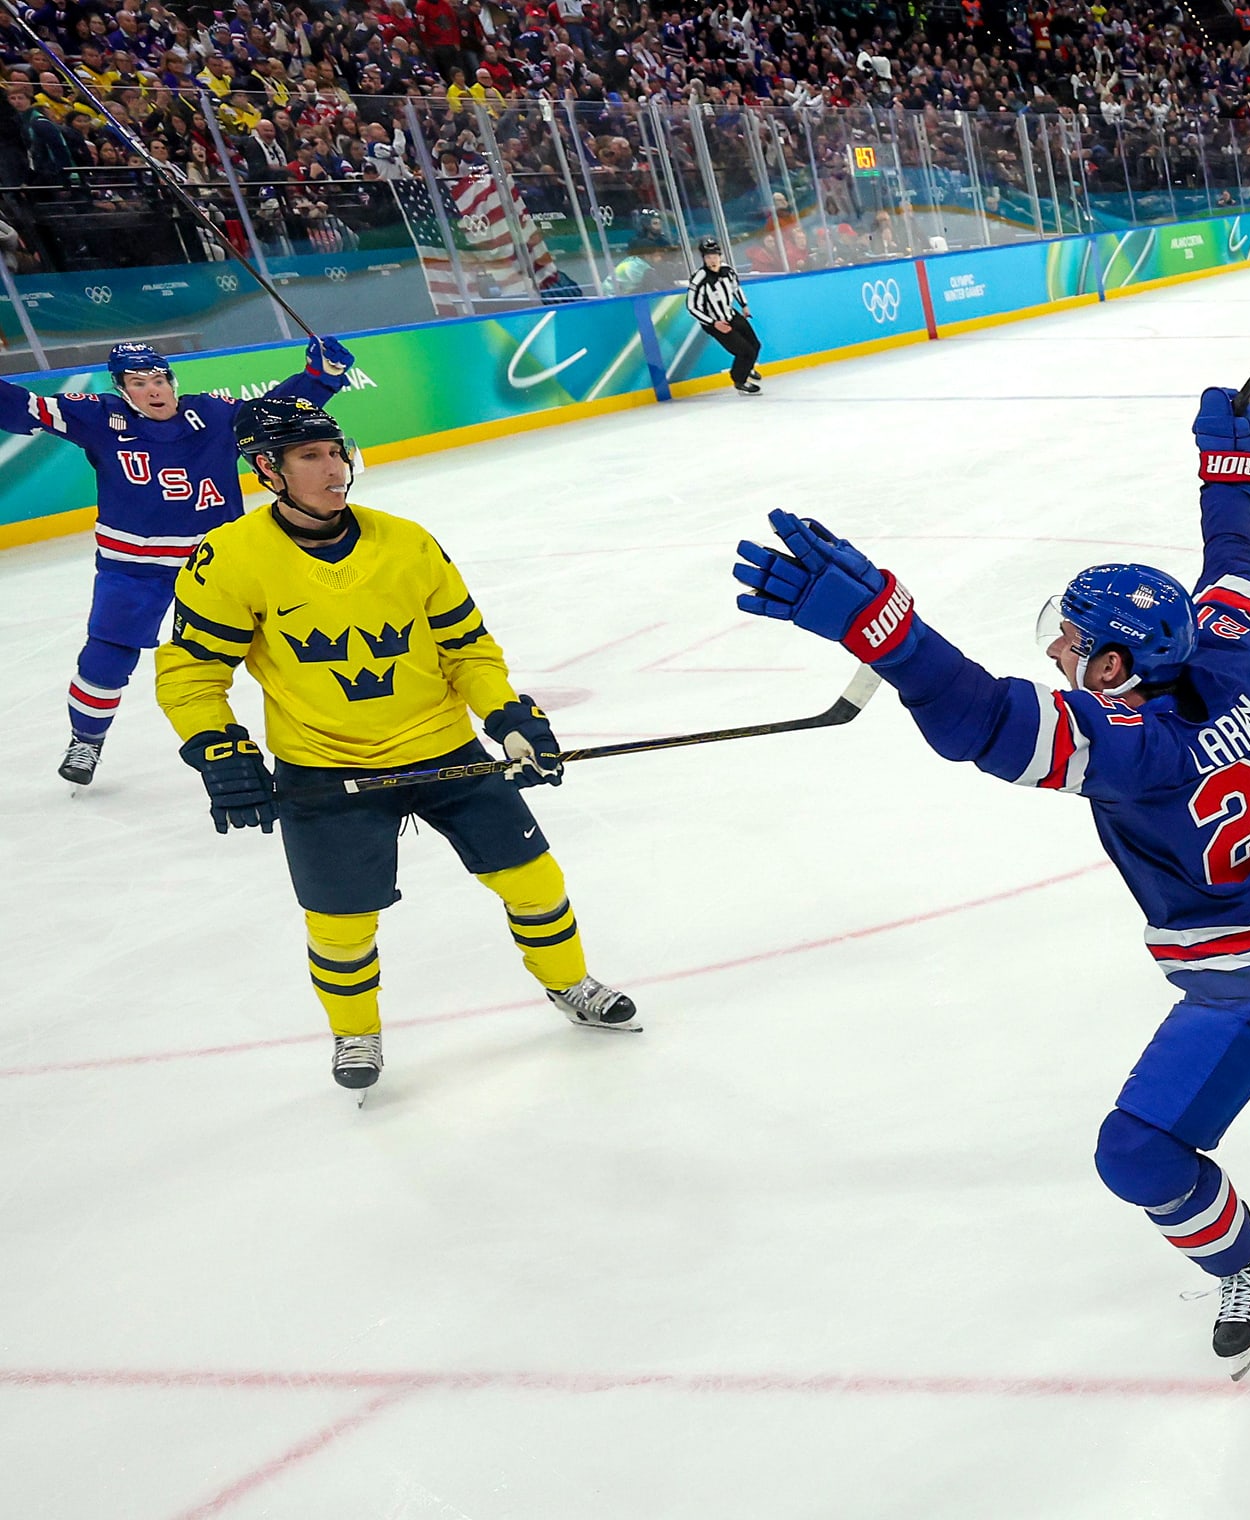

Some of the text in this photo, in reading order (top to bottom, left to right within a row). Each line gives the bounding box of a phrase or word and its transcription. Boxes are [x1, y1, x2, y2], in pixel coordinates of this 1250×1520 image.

[184, 409, 206, 431] A
[239, 435, 255, 446] CCM
[118, 450, 226, 511] USA
[1140, 585, 1153, 594] USA
[1109, 620, 1147, 640] CCM
